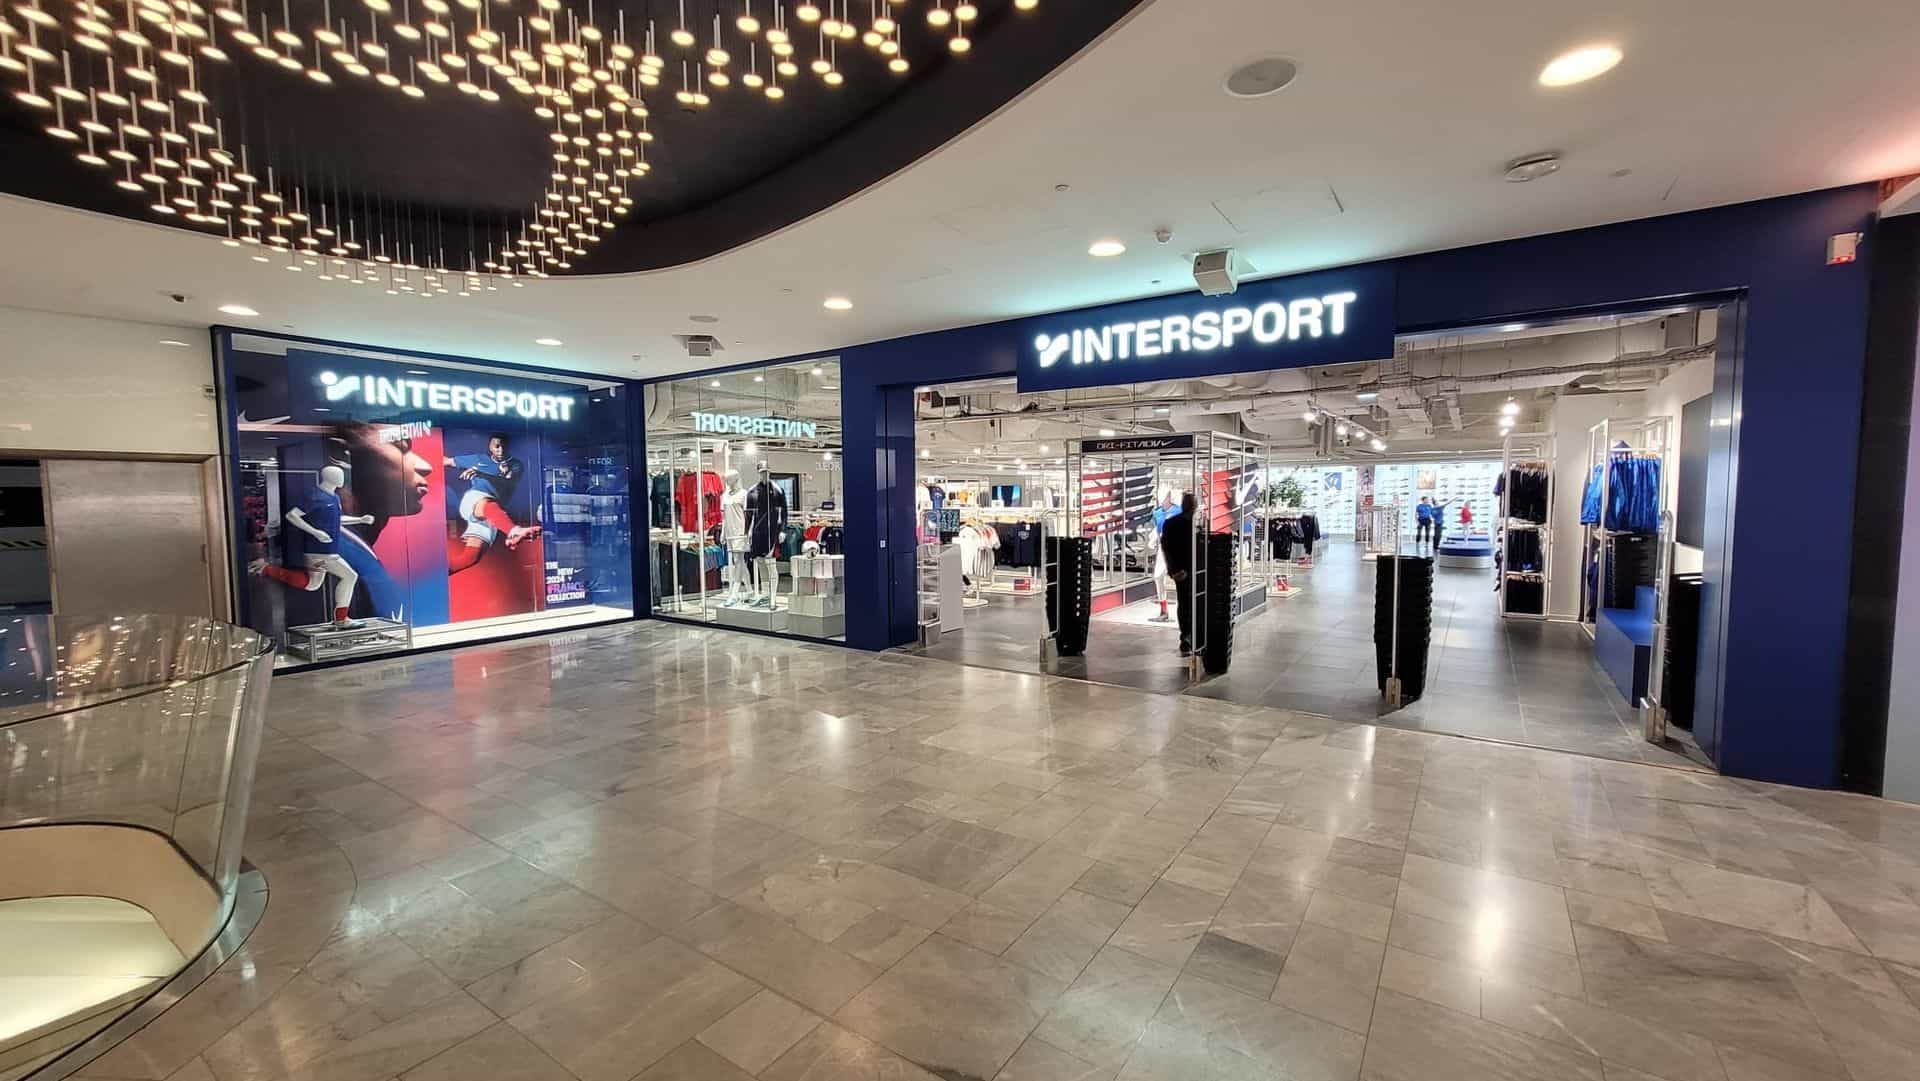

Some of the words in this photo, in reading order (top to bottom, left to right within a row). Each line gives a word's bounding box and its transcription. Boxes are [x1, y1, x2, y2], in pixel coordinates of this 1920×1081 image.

[1072, 291, 1357, 365] INTERSPORT
[364, 374, 575, 421] INTERSPORT
[546, 582, 585, 593] FRANCE
[546, 591, 585, 601] COLLECTION
